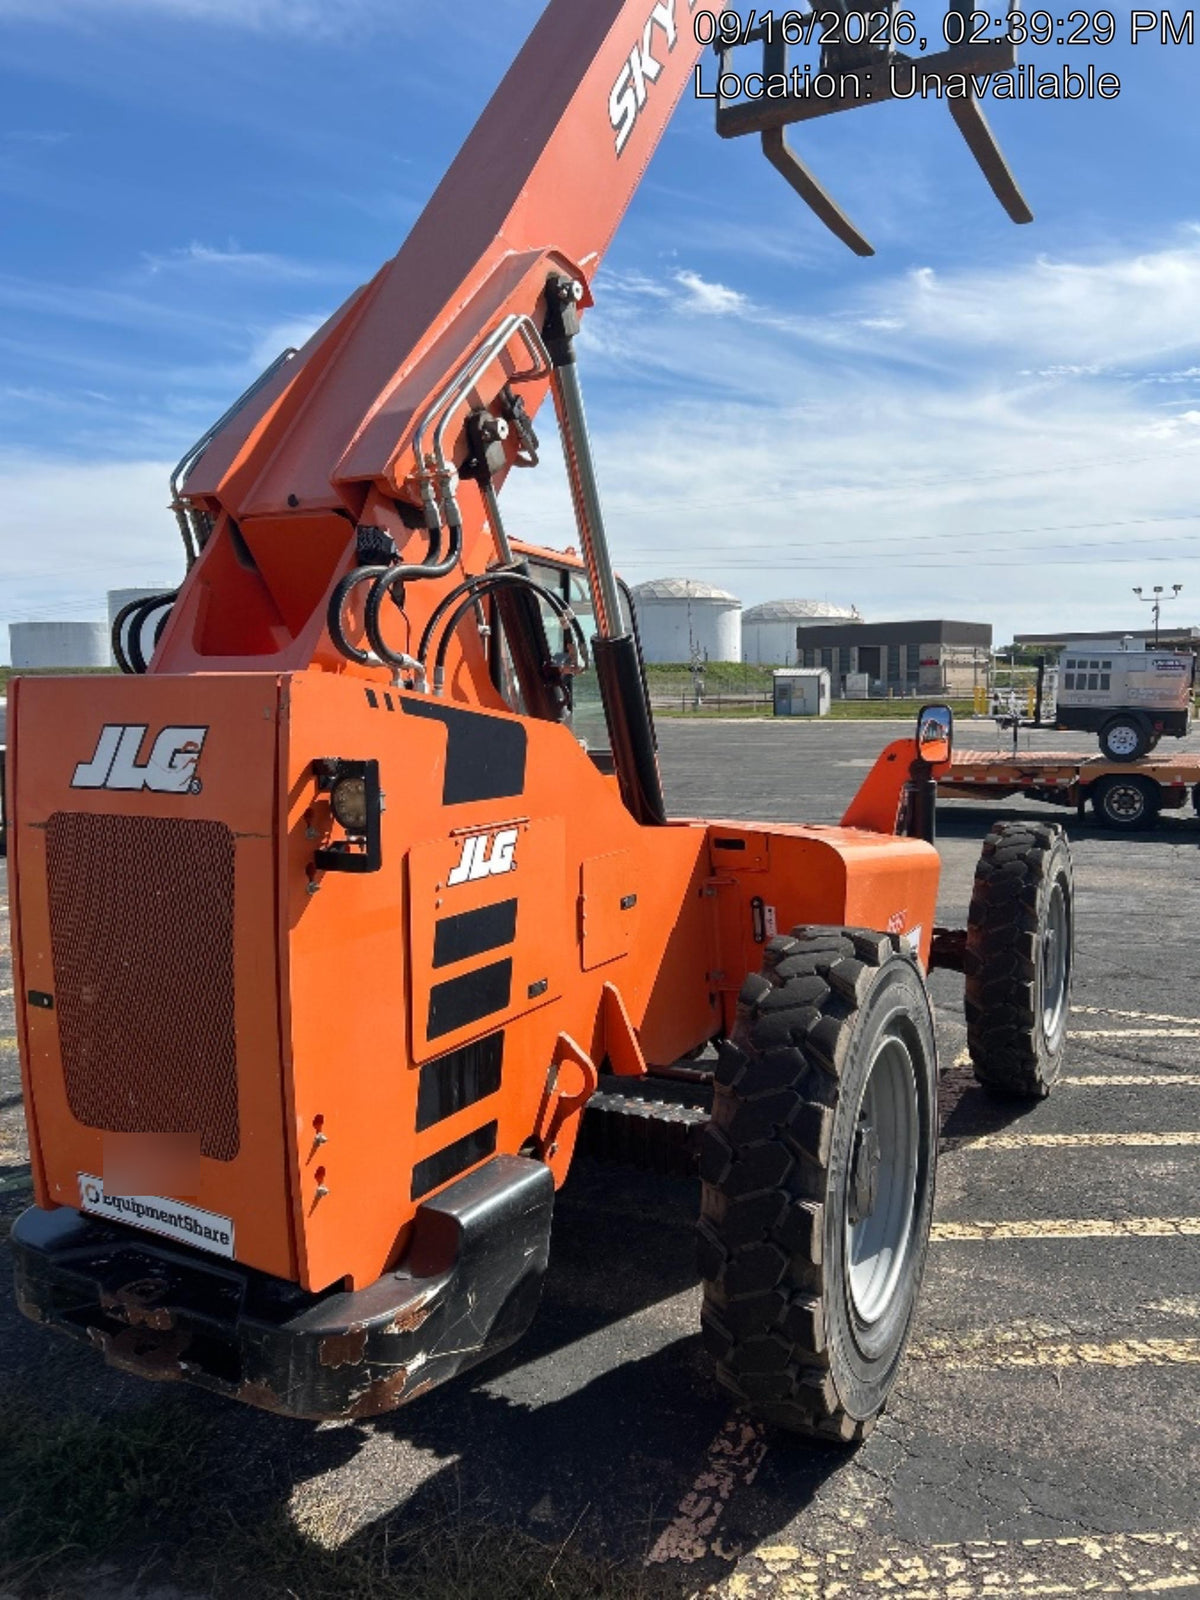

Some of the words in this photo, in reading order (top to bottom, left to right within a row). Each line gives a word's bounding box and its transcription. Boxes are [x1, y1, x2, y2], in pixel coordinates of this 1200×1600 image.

[608, 0, 697, 160] SKY
[70, 724, 209, 794] JLG
[446, 827, 519, 888] JLG
